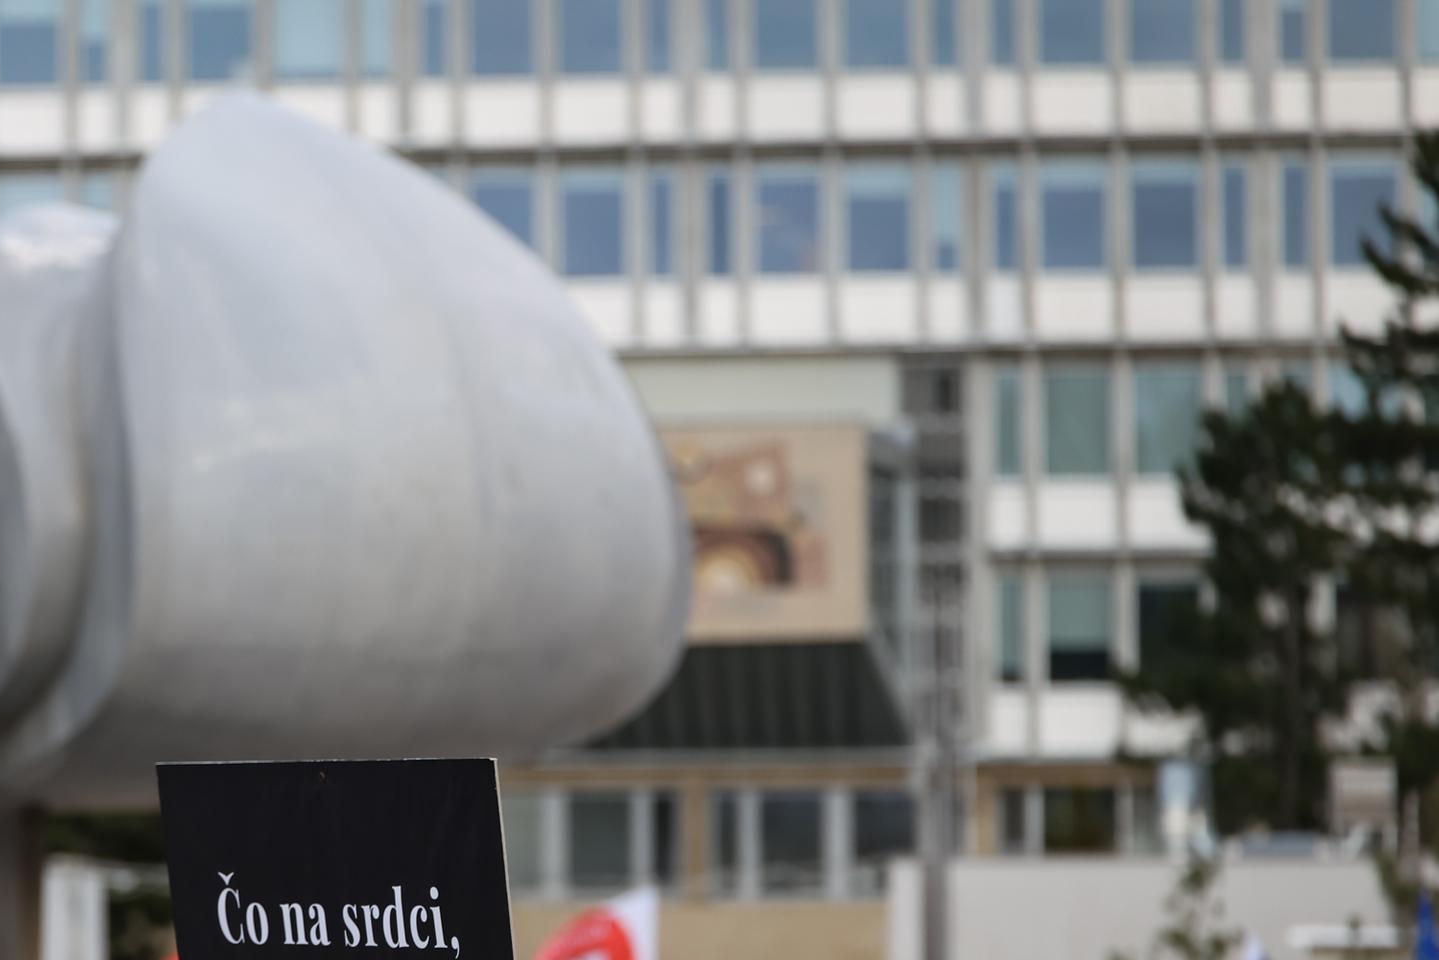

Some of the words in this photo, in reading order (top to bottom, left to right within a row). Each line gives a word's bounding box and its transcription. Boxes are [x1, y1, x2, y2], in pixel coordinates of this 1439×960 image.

[216, 871, 269, 945] Čo
[279, 901, 331, 946] na
[342, 884, 460, 959] srdci,
